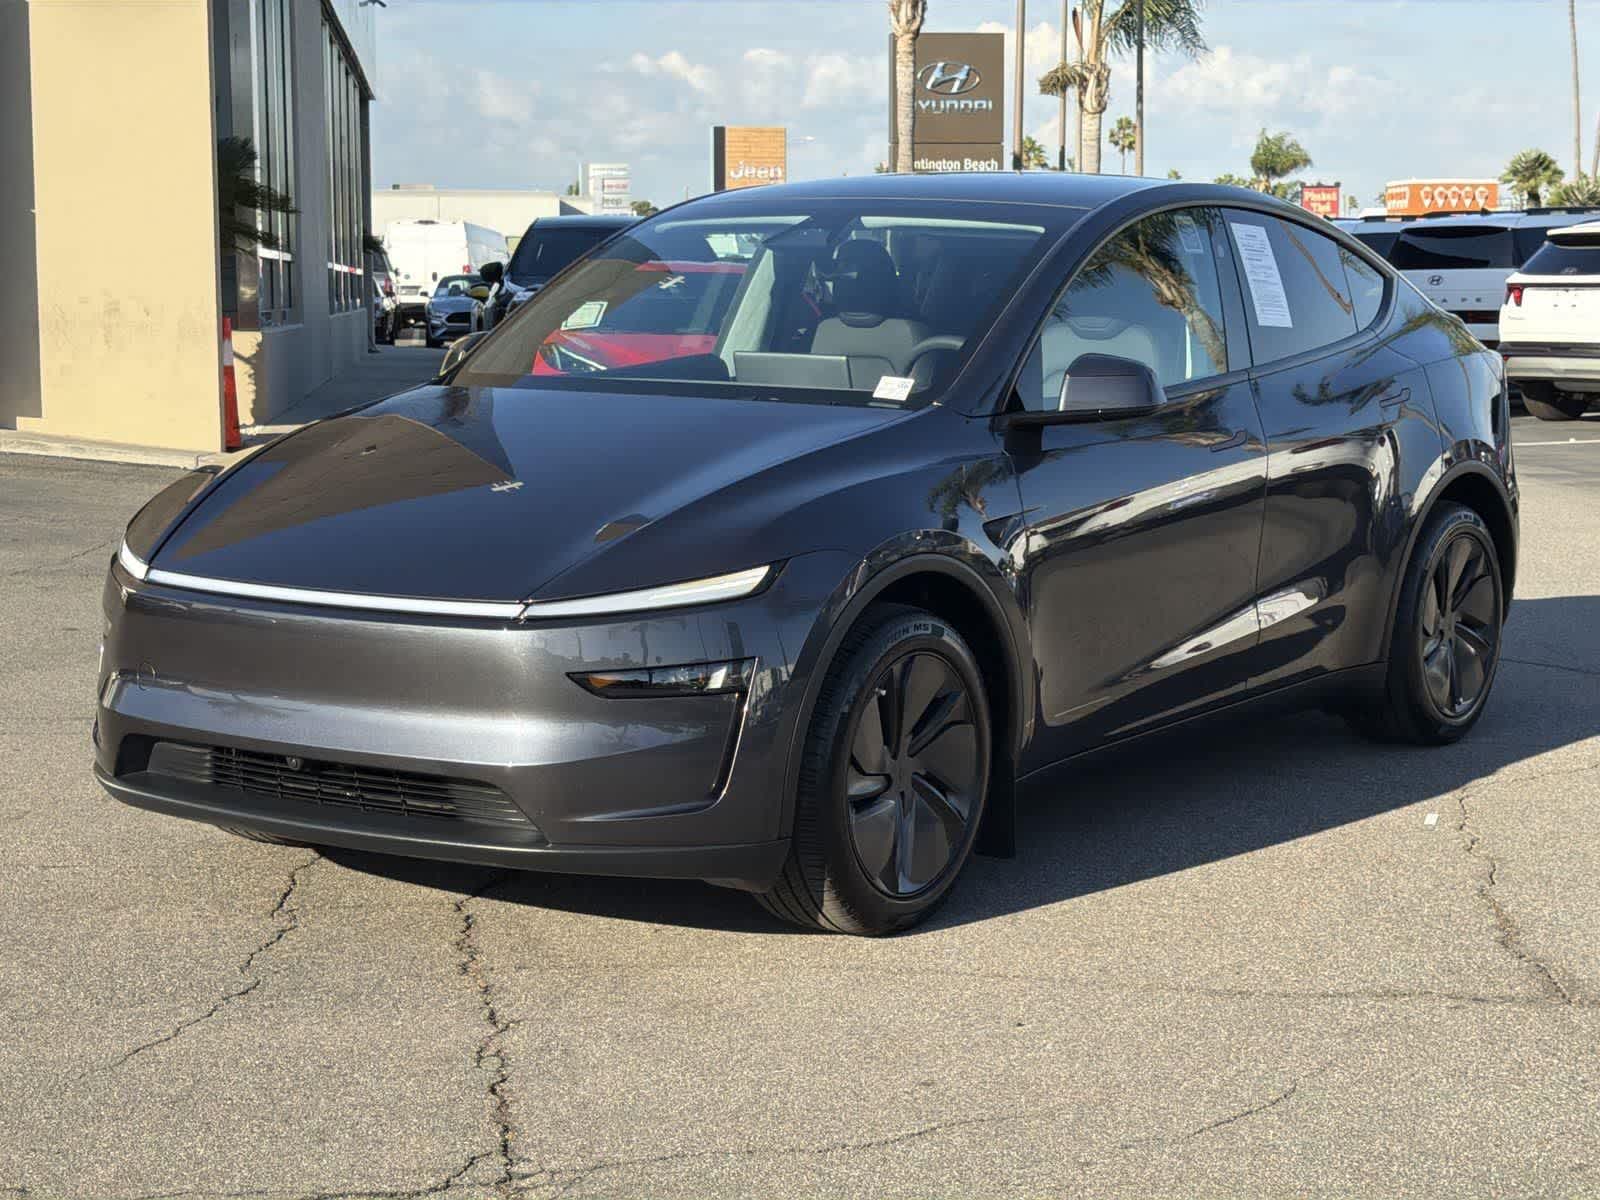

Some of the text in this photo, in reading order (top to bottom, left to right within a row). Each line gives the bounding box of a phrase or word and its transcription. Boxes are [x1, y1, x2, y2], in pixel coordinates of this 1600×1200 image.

[917, 99, 993, 114] YUNDAI
[914, 158, 999, 172] ntington Beach
